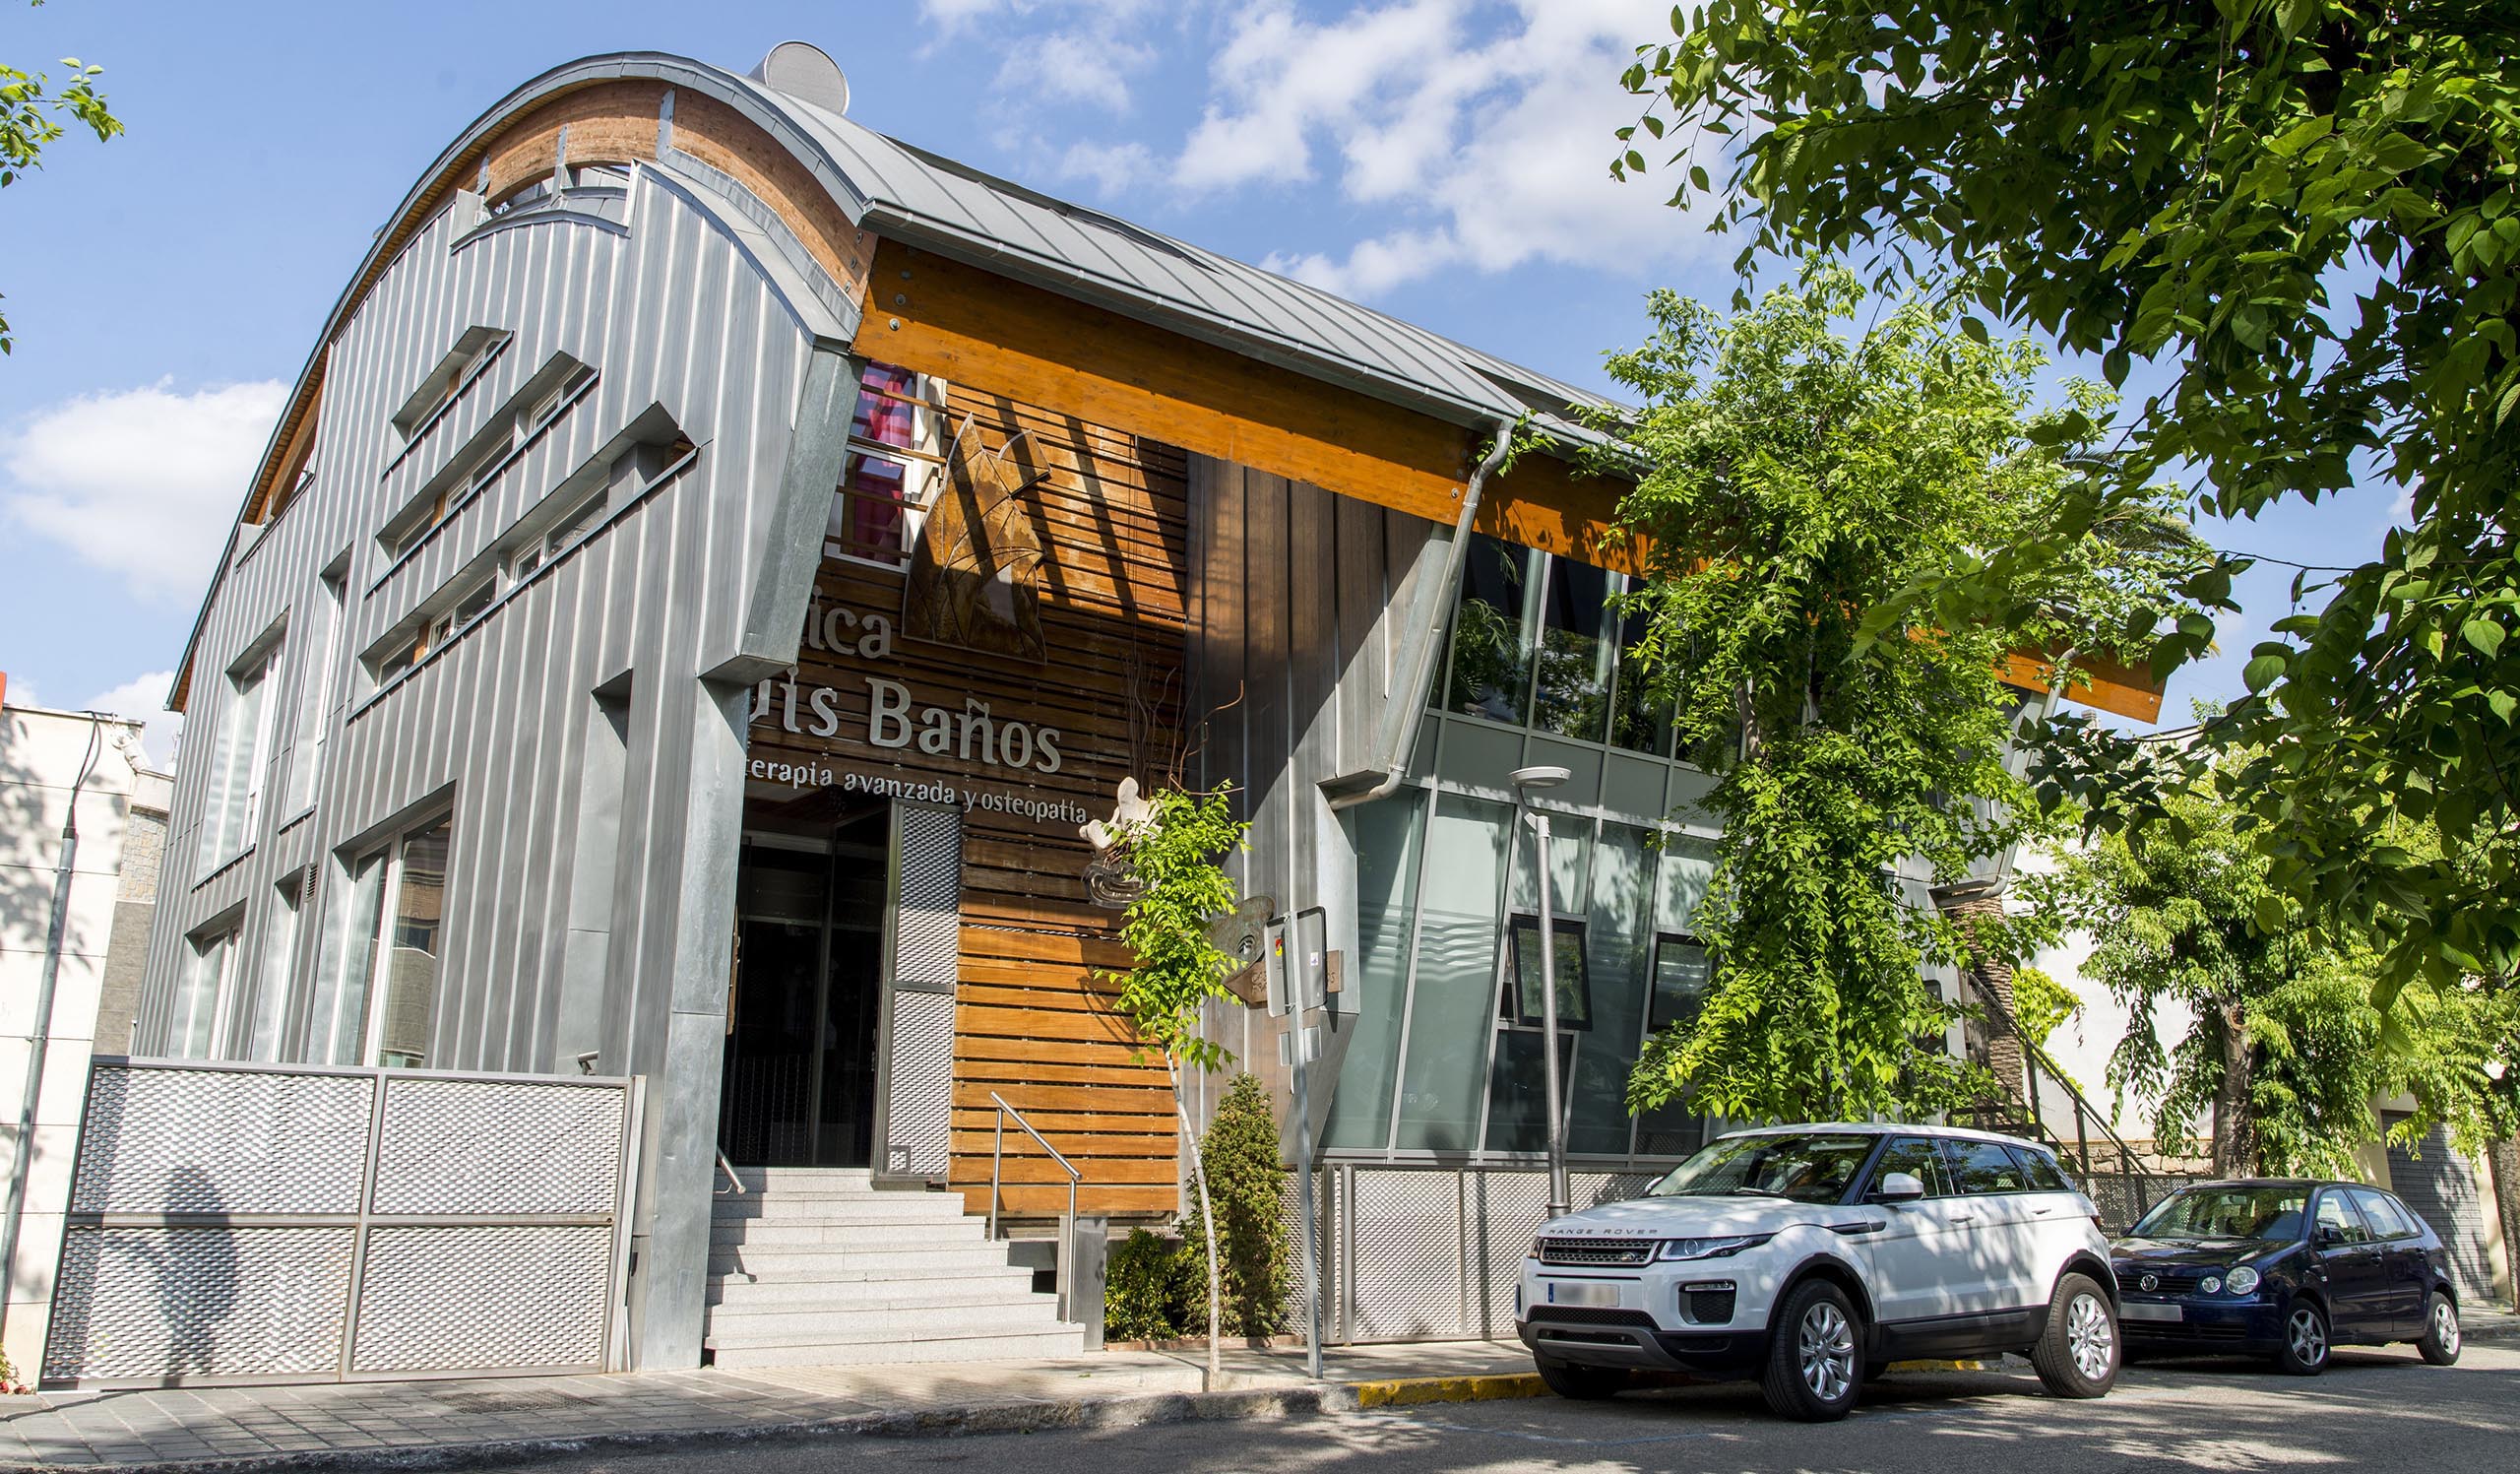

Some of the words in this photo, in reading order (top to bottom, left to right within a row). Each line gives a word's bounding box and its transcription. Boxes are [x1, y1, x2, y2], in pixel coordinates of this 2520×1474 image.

[802, 585, 892, 659] ica
[864, 676, 1061, 774] Baños
[745, 759, 833, 789] erapia
[844, 773, 956, 804] avanzada
[963, 790, 977, 813] y
[980, 791, 1087, 824] osteopatía
